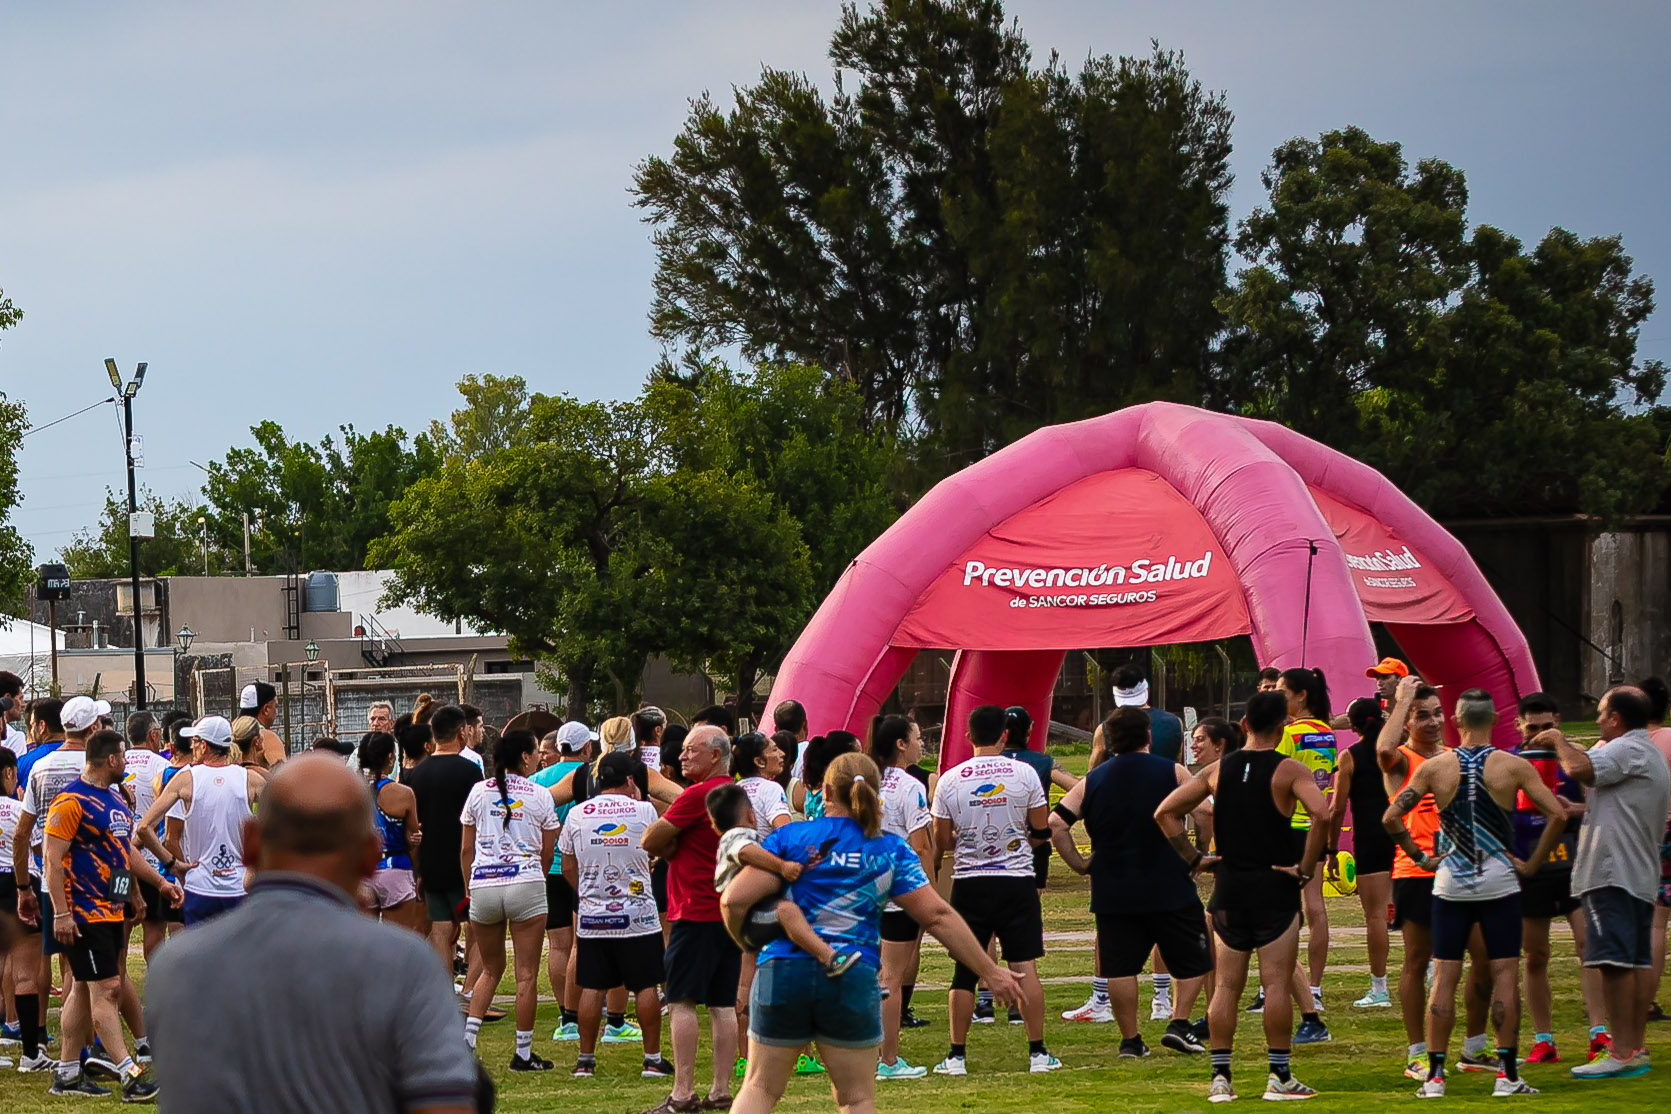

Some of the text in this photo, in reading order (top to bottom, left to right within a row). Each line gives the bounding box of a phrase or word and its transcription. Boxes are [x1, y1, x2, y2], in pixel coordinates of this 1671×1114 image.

[962, 551, 1212, 588] Prevención Salud
[1009, 590, 1157, 608] de SANCOR SEGUROS
[974, 768, 1014, 776] SEGUROS
[505, 779, 534, 787] ANCOR
[507, 785, 534, 793] GUROS
[597, 807, 637, 815] SEGUROS
[591, 838, 629, 846] REDCOLOR
[113, 876, 130, 895] 162
